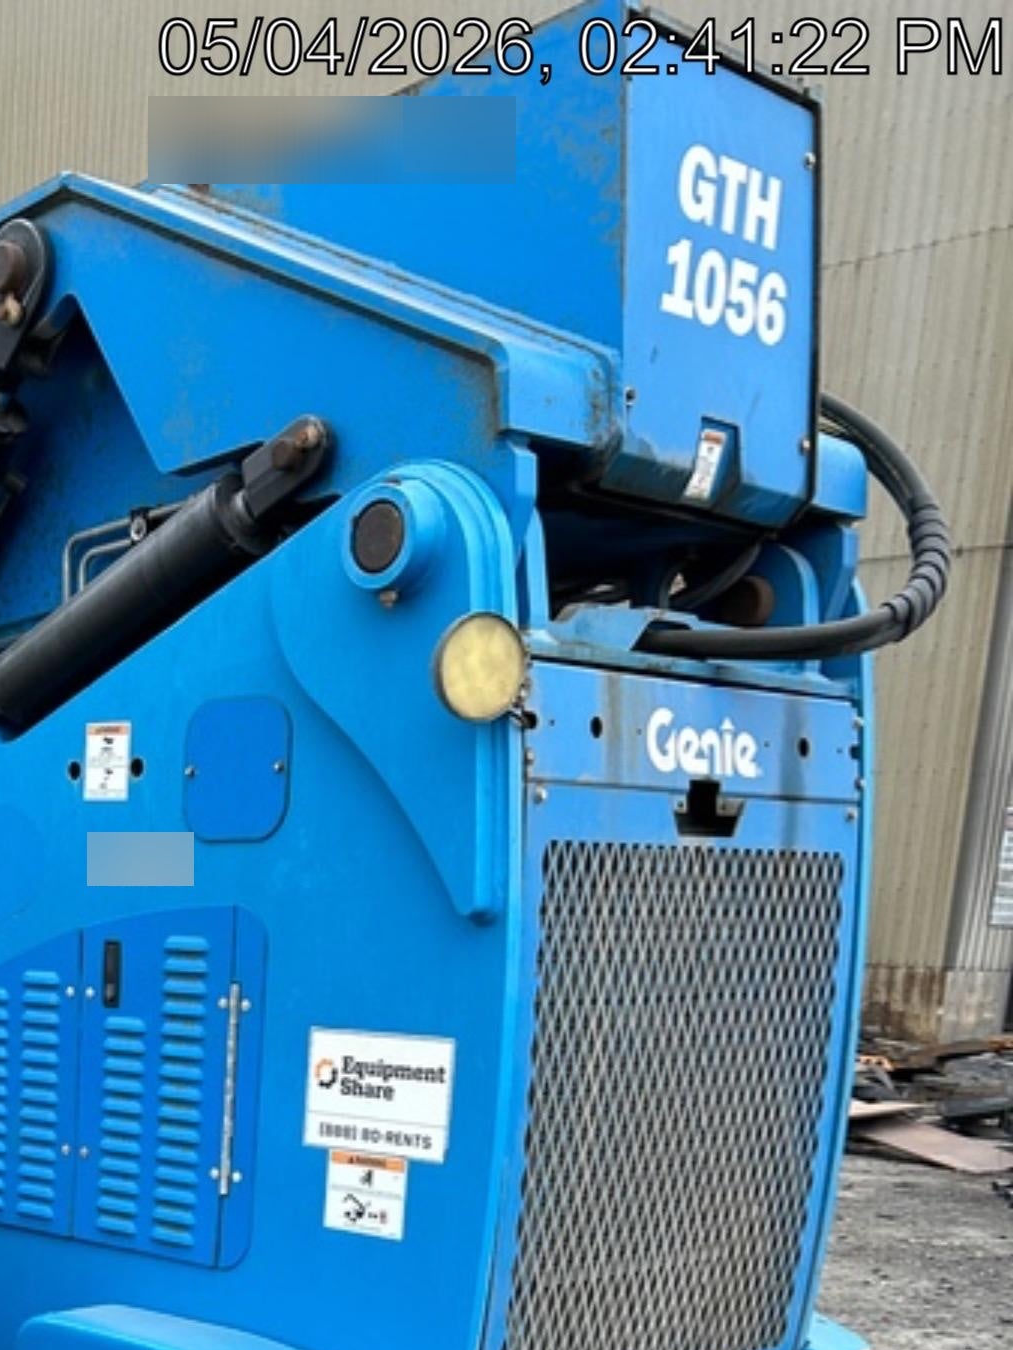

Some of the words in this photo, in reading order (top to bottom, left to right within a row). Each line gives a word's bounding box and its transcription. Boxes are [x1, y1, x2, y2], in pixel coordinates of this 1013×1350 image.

[679, 144, 781, 250] GTH
[660, 239, 787, 346] 1056
[646, 707, 757, 778] Genie
[340, 1077, 395, 1101] Share
[341, 1056, 446, 1084] Equipment
